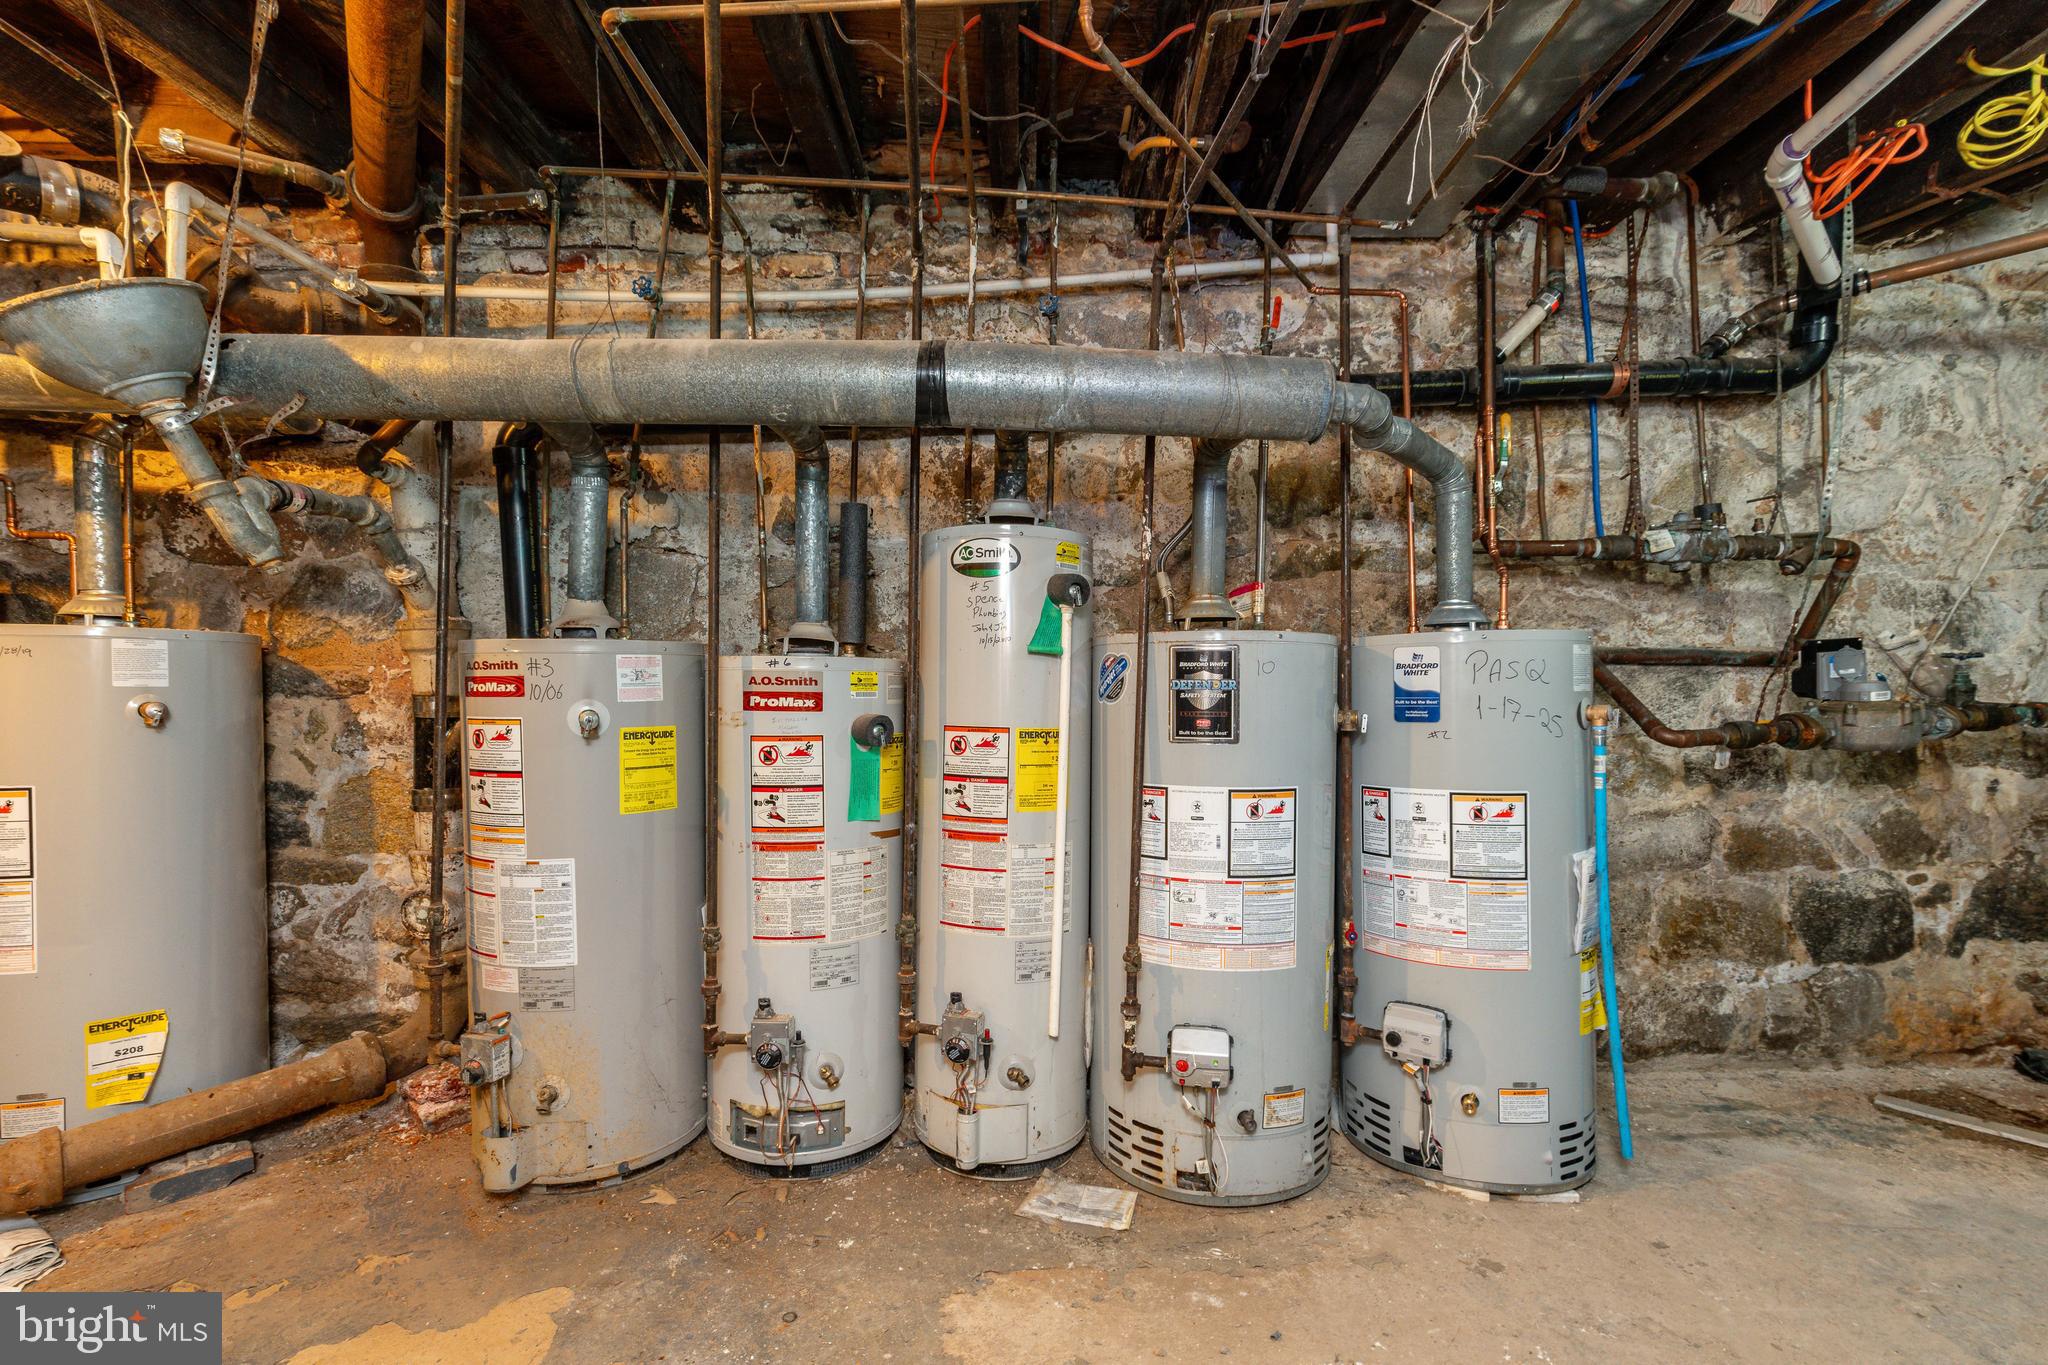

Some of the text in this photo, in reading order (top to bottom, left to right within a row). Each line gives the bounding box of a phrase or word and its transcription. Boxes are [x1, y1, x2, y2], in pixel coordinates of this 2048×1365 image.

[526, 657, 554, 678] #3
[1257, 659, 1276, 677] 10
[1395, 662, 1439, 670] BRADFORD
[1465, 649, 1550, 685] PASQ
[467, 682, 516, 692] ProMax
[748, 676, 818, 686] A.O.Smith
[1171, 679, 1238, 691] DEFENDER
[529, 680, 563, 702] 10/06
[749, 696, 815, 707] ProMax
[1476, 694, 1564, 738] 1-17-25
[623, 730, 675, 741] ENERGYGUIDE
[88, 1012, 166, 1034] ENERGYGUIDE
